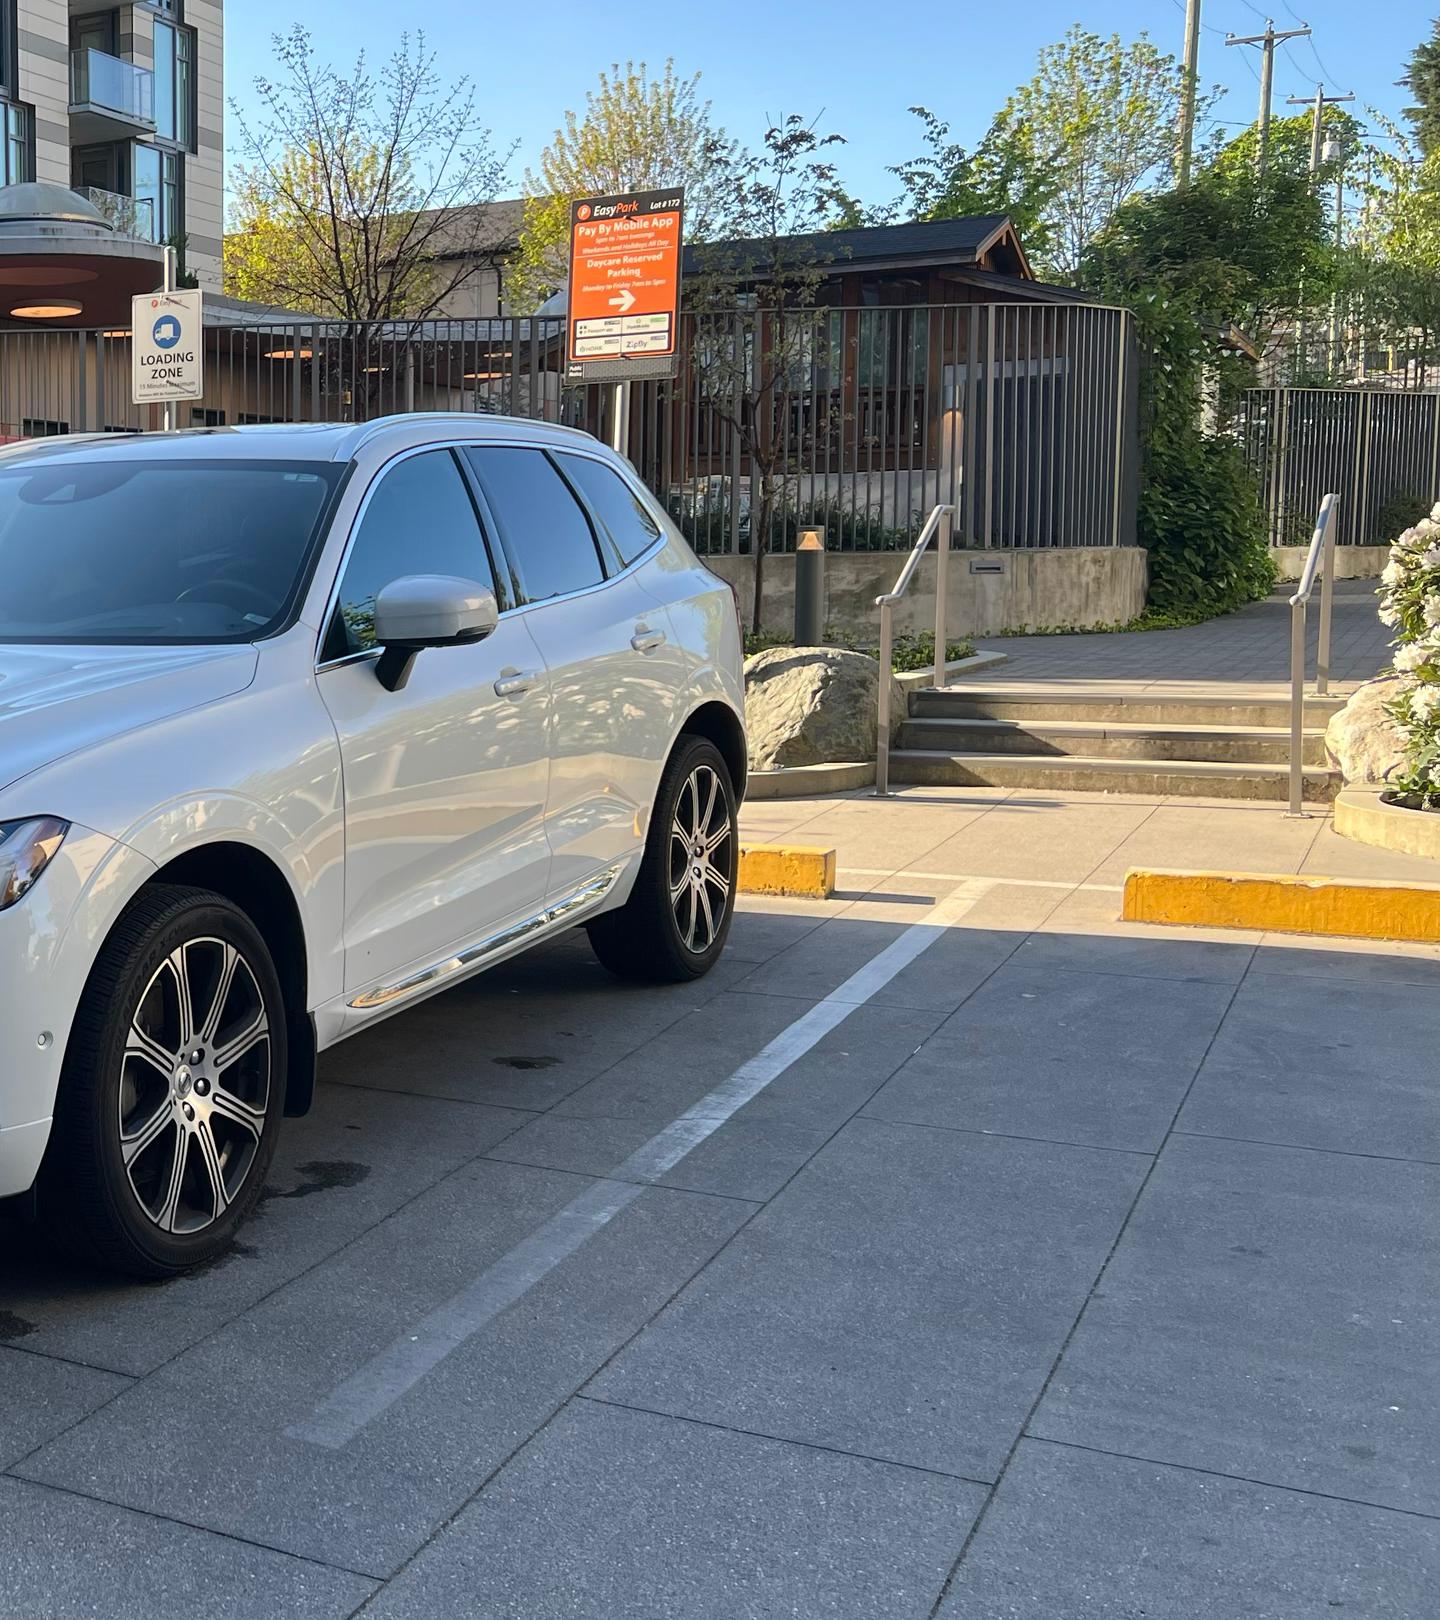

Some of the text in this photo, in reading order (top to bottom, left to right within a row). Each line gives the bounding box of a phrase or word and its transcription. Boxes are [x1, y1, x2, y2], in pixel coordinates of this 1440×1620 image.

[593, 200, 639, 217] EasyPark
[650, 202, 660, 210] Lot
[578, 217, 673, 237] Pay By Mobile App
[587, 252, 663, 269] Daycare Reserved
[607, 267, 641, 279] Parking
[141, 351, 194, 366] LOADING
[152, 367, 183, 379] ZONE
